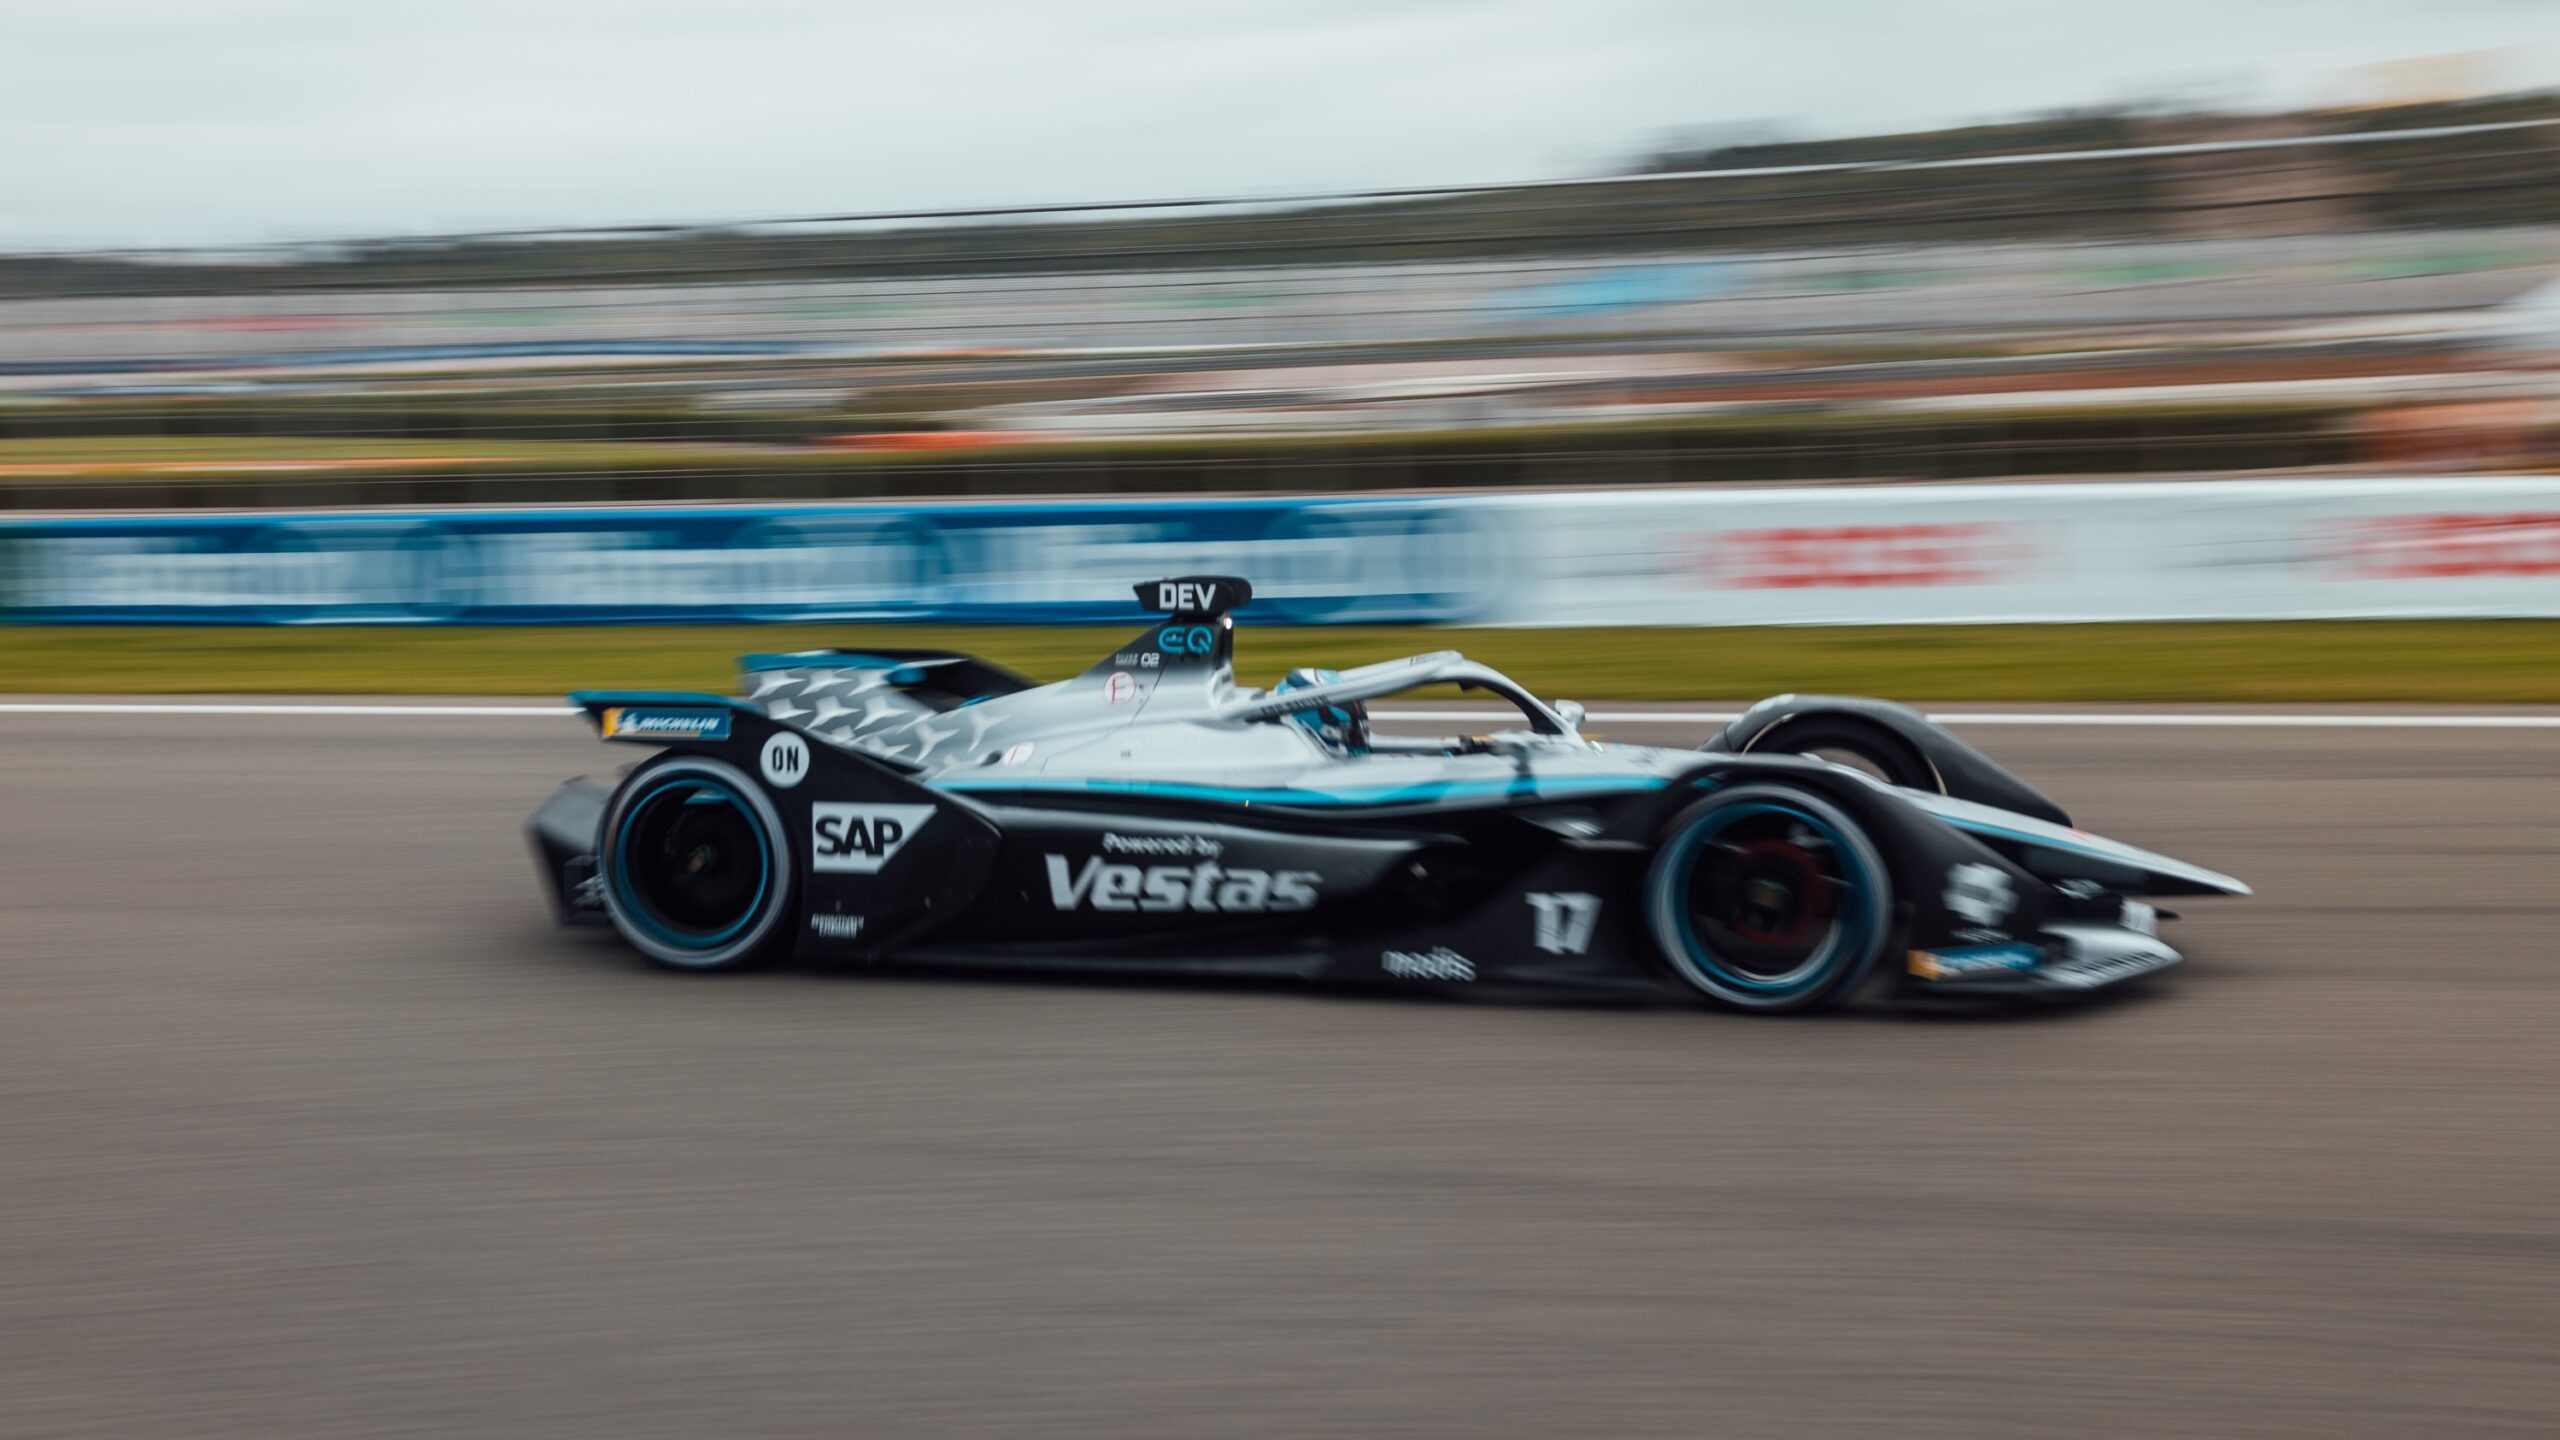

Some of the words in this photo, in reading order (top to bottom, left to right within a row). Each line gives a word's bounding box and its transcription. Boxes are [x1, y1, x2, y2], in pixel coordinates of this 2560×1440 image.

[1159, 583, 1216, 610] DEV
[1158, 625, 1213, 654] EQ
[1140, 652, 1160, 668] 02
[638, 717, 720, 733] MICHELIN
[771, 745, 800, 773] ON
[815, 815, 904, 858] SAP
[1102, 832, 1193, 855] Powered
[1195, 834, 1224, 858] by
[1045, 853, 1324, 912] Vestas
[1525, 892, 1603, 954] 17
